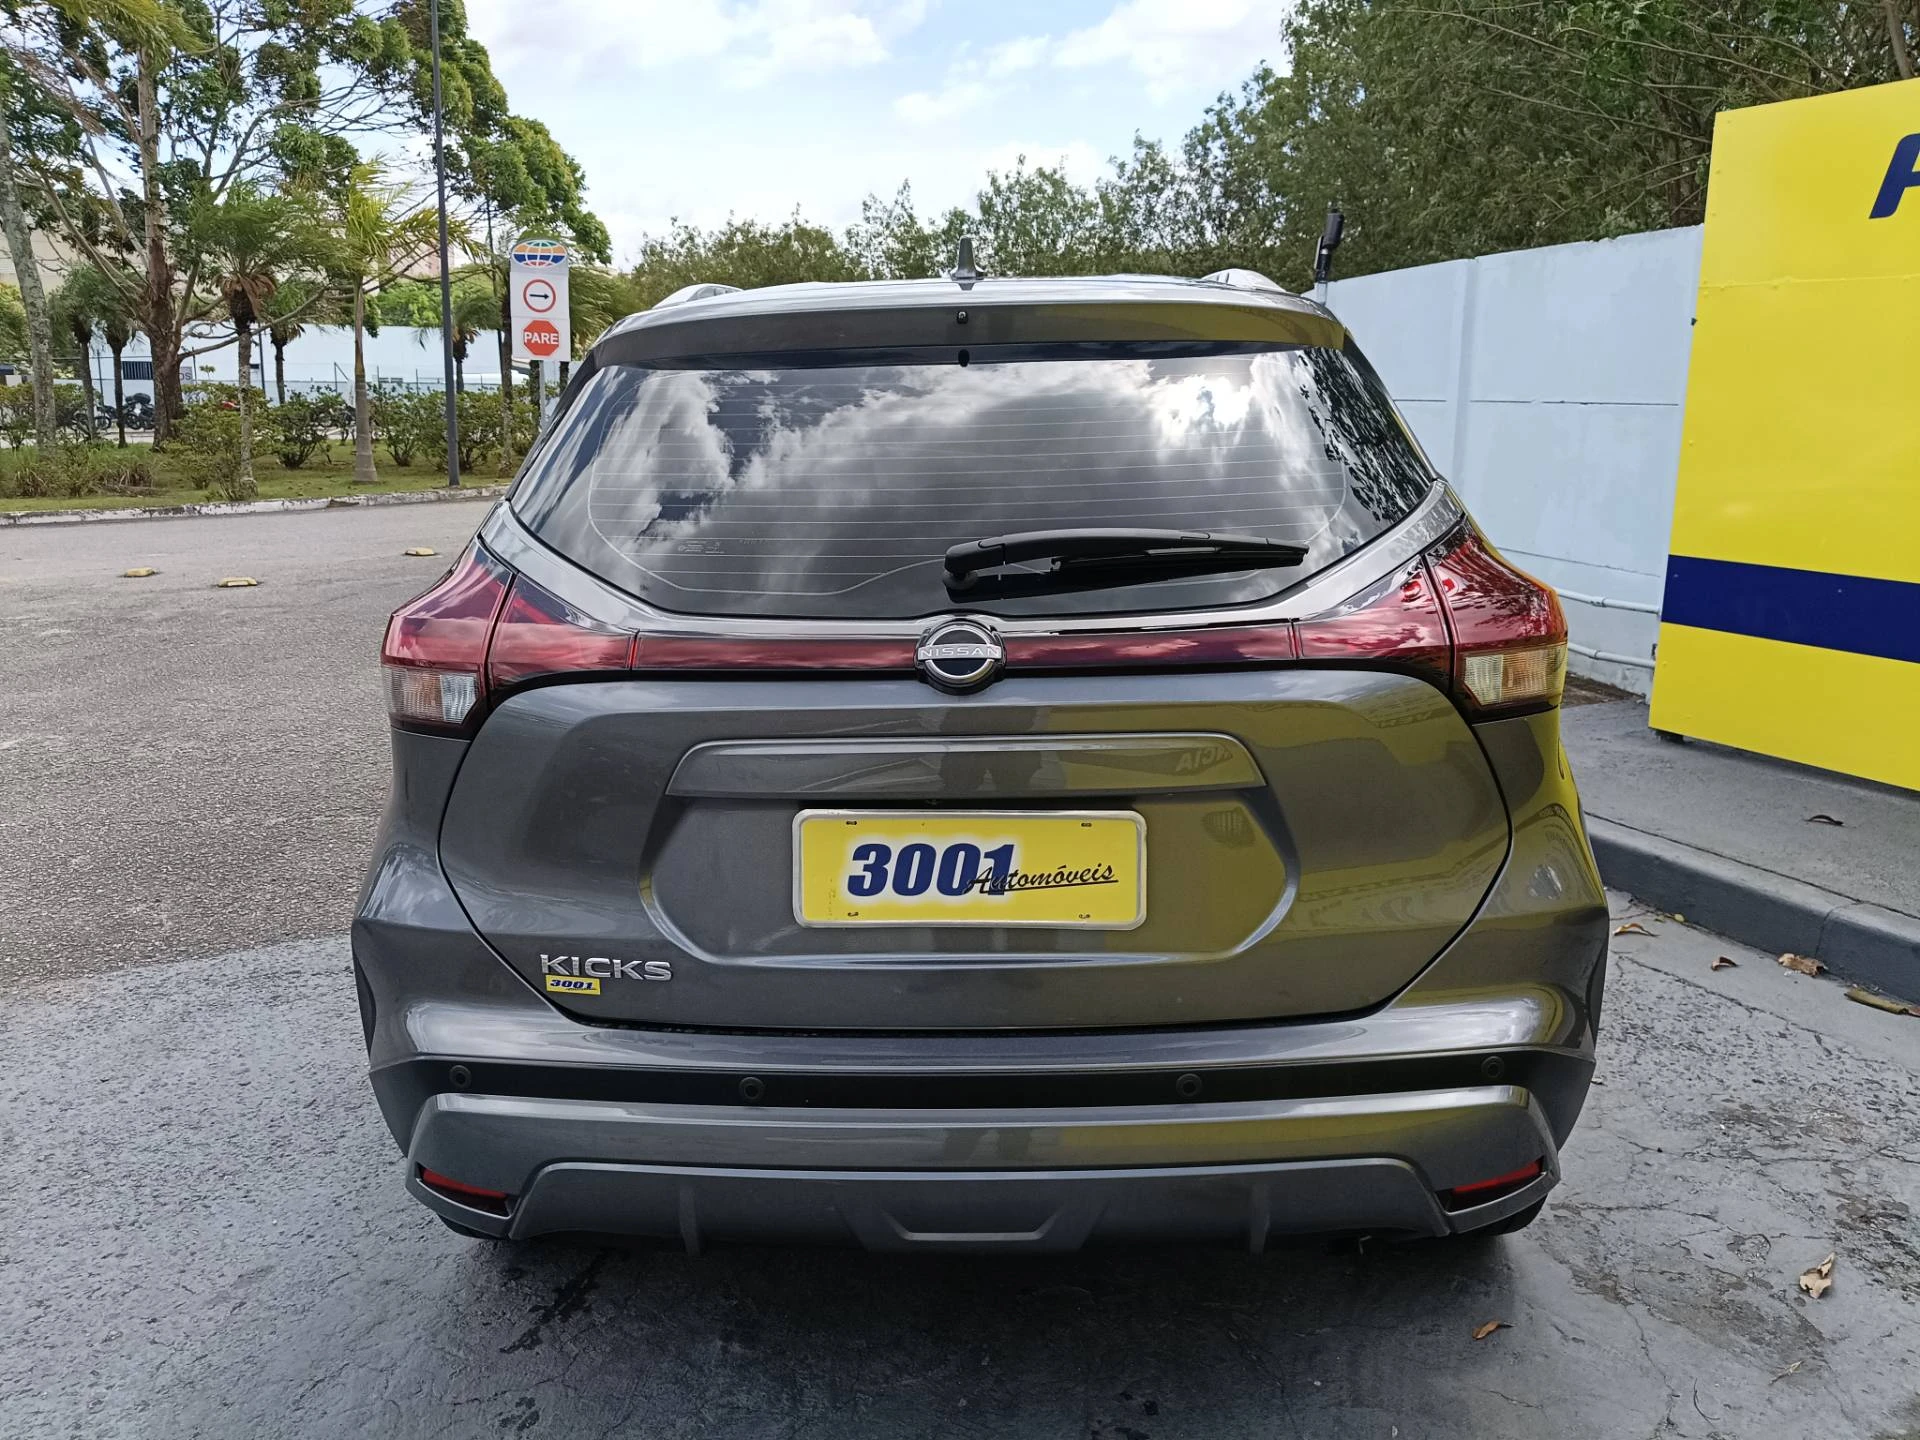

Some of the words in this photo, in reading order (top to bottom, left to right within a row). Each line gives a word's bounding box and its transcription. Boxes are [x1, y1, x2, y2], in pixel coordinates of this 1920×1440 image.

[524, 331, 559, 345] PARE
[920, 647, 999, 657] NISSAN
[847, 842, 1015, 897] 3001
[963, 862, 1118, 894] Automóveis
[540, 954, 672, 981] KICKS
[550, 979, 593, 989] 3001
